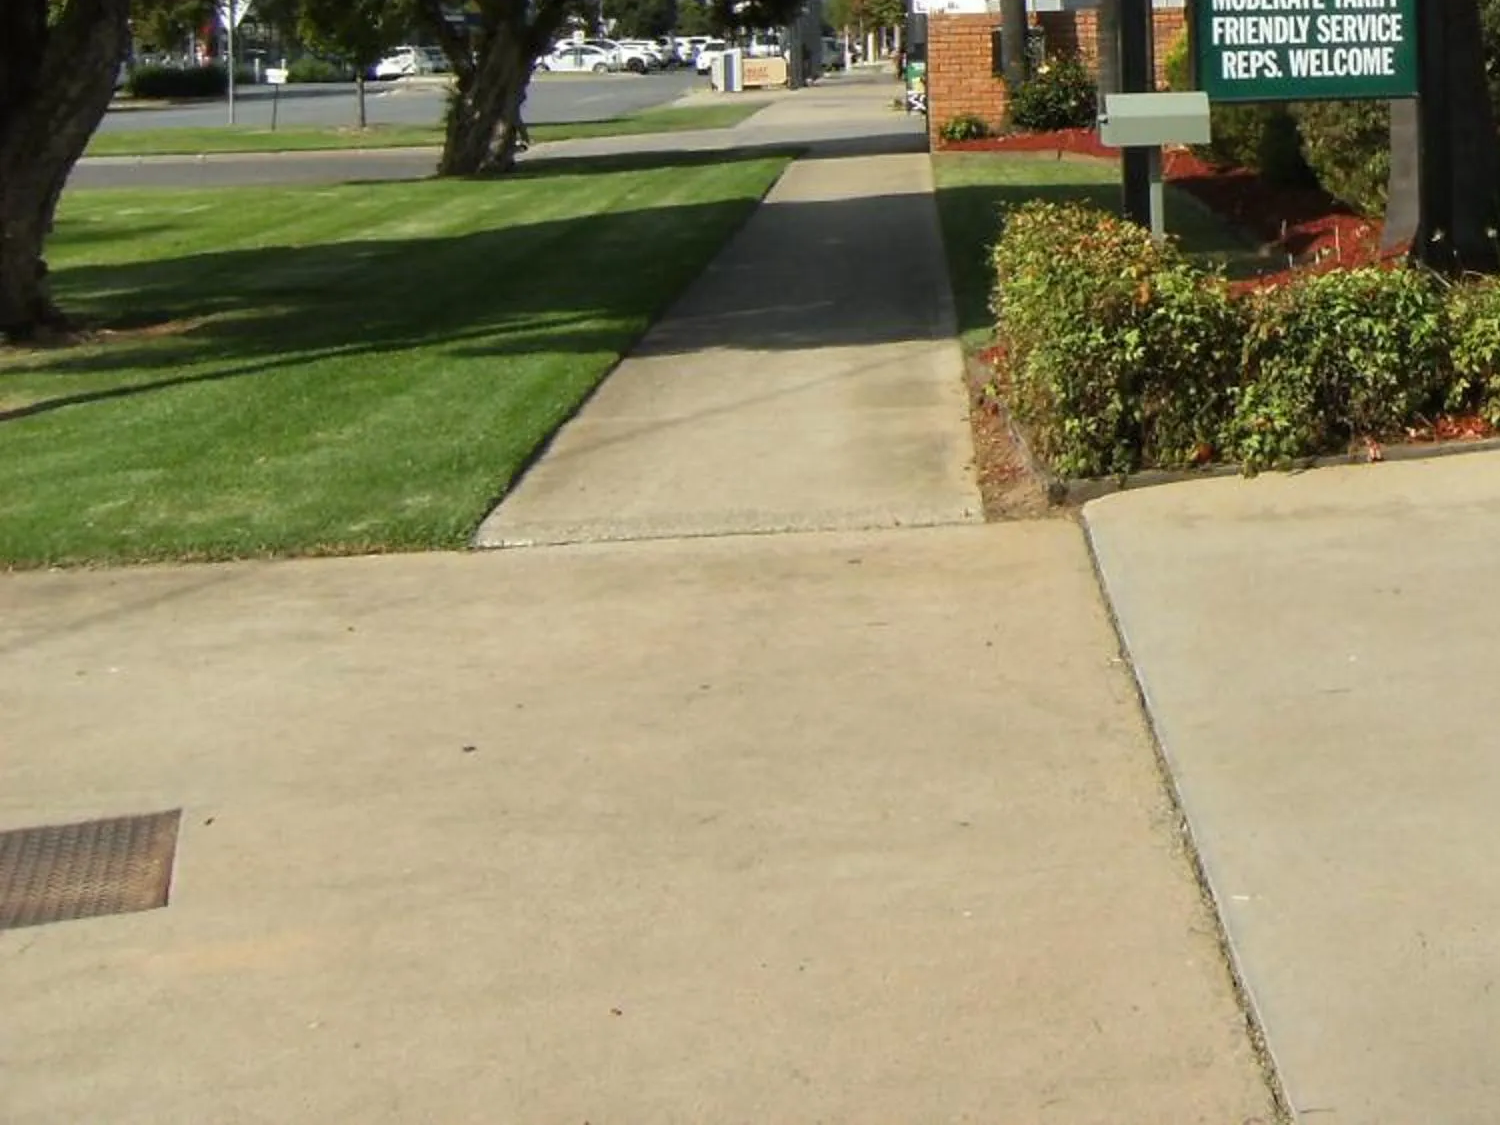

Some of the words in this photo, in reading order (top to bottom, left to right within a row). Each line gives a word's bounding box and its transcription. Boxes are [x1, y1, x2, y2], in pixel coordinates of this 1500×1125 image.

[1212, 15, 1311, 45] FRIENDLY
[1317, 13, 1403, 43] SERVICE
[1221, 49, 1283, 79] REPS.
[1287, 47, 1395, 77] WELCOME
